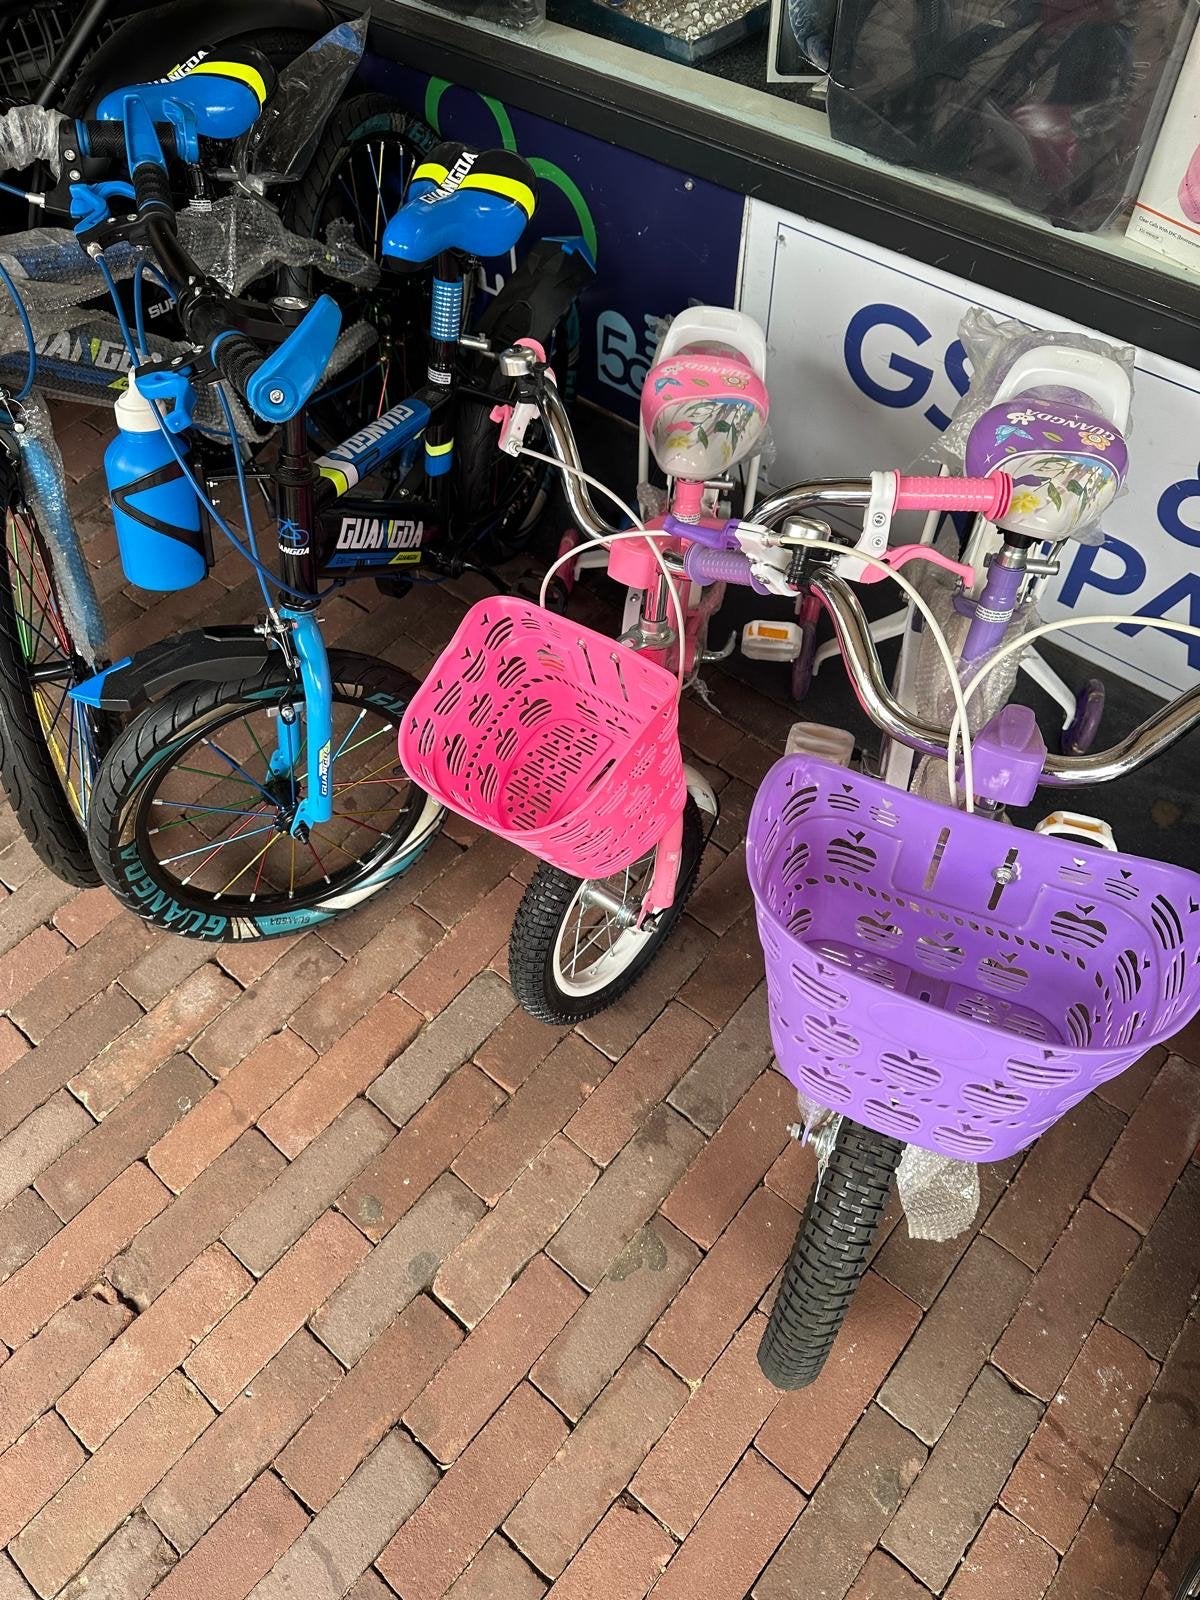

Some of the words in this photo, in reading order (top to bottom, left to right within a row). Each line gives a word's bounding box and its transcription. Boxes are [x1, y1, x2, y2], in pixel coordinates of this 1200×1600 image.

[327, 404, 415, 460] GUANGDA
[1025, 408, 1116, 441] GUANGDA
[336, 517, 424, 549] GUANGDA
[120, 841, 228, 936] GUANGDA
